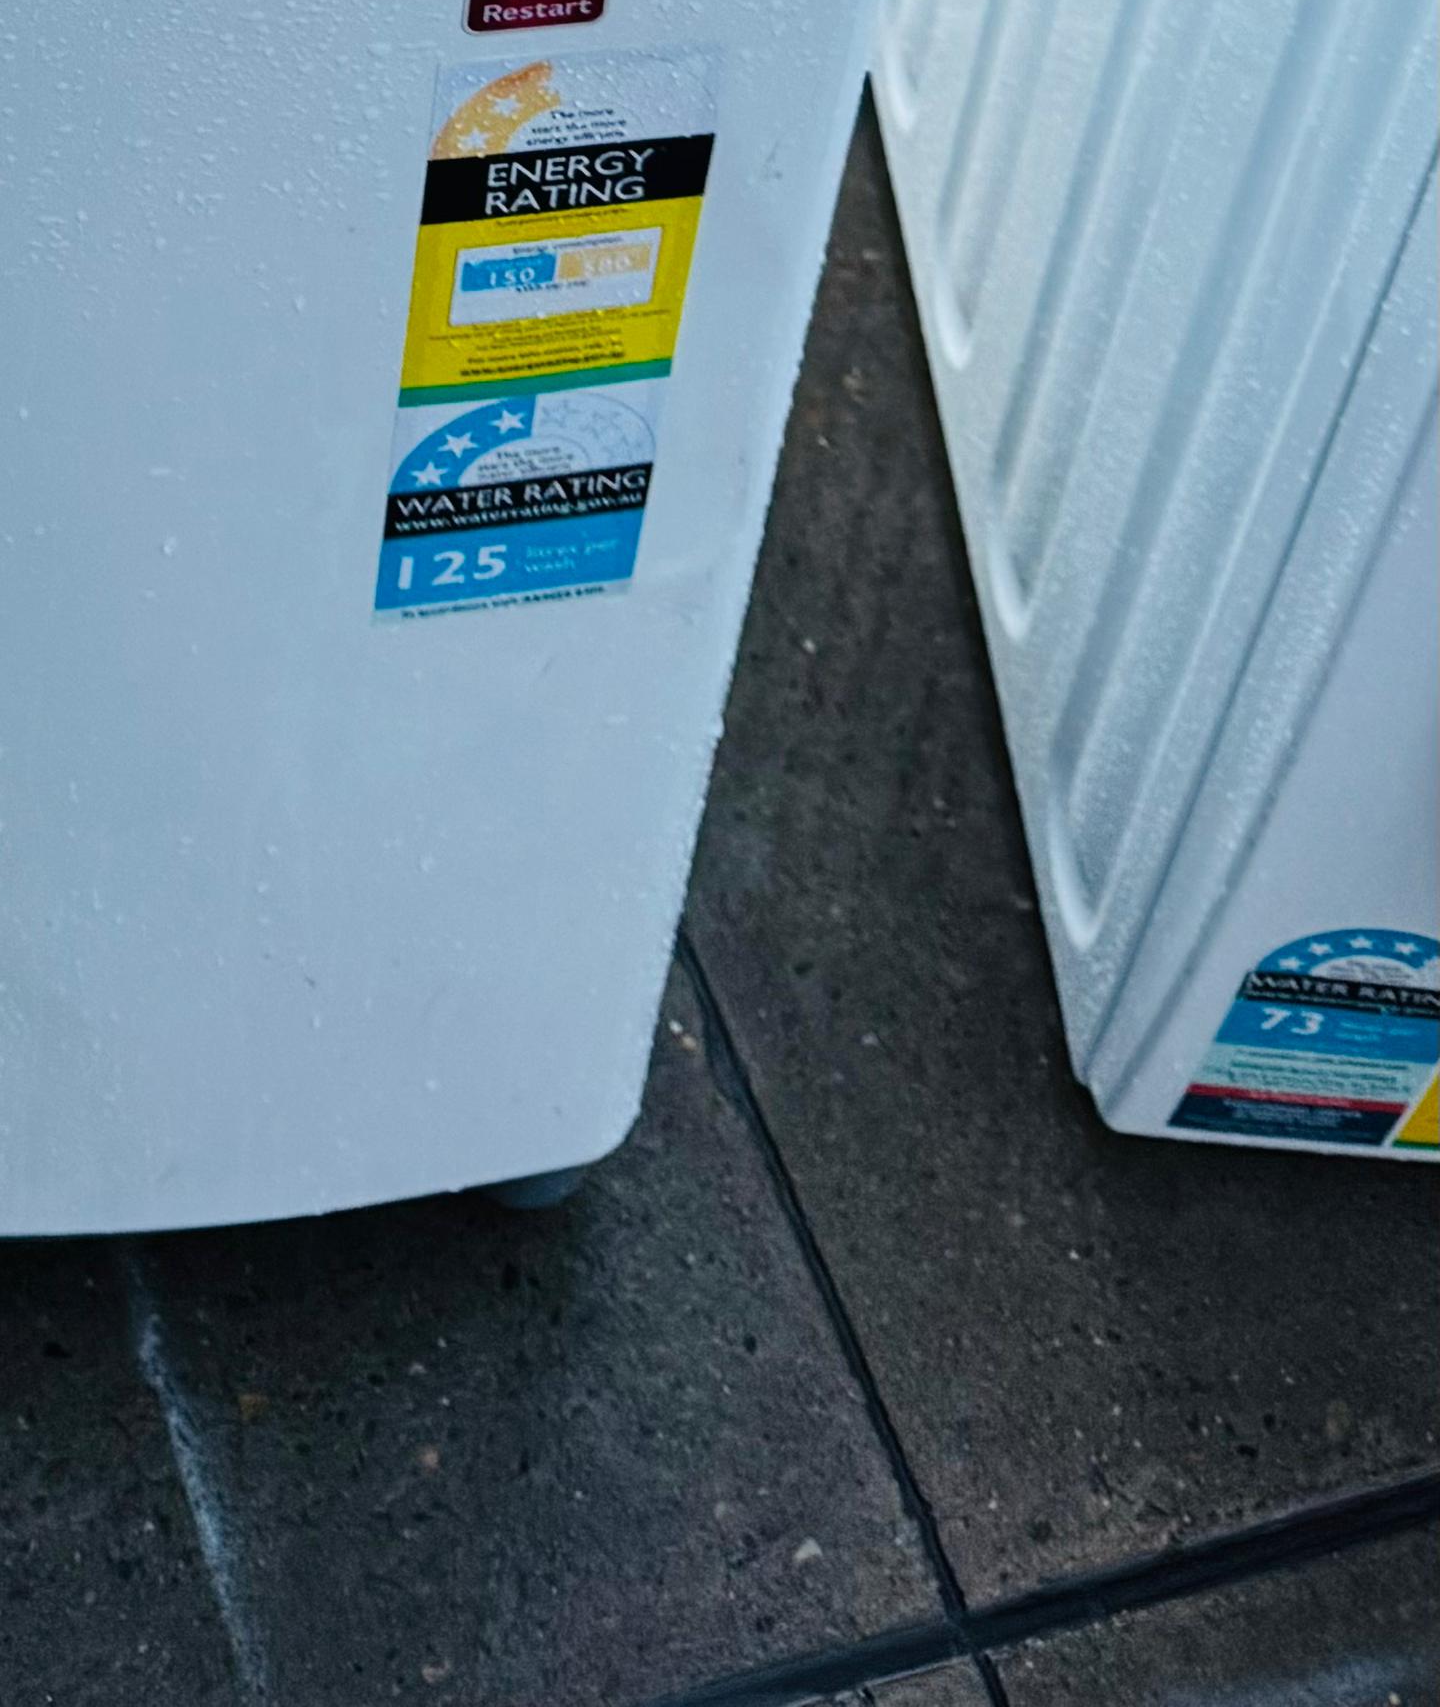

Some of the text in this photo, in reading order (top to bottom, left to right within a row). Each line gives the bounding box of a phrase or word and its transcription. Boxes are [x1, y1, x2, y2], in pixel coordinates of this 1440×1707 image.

[486, 147, 655, 188] ENERGY
[484, 175, 646, 216] RATING
[396, 484, 514, 518] WATER
[523, 468, 647, 504] RATING
[397, 544, 508, 591] 125
[1247, 971, 1349, 997] WATER
[1260, 1007, 1326, 1035] 73
